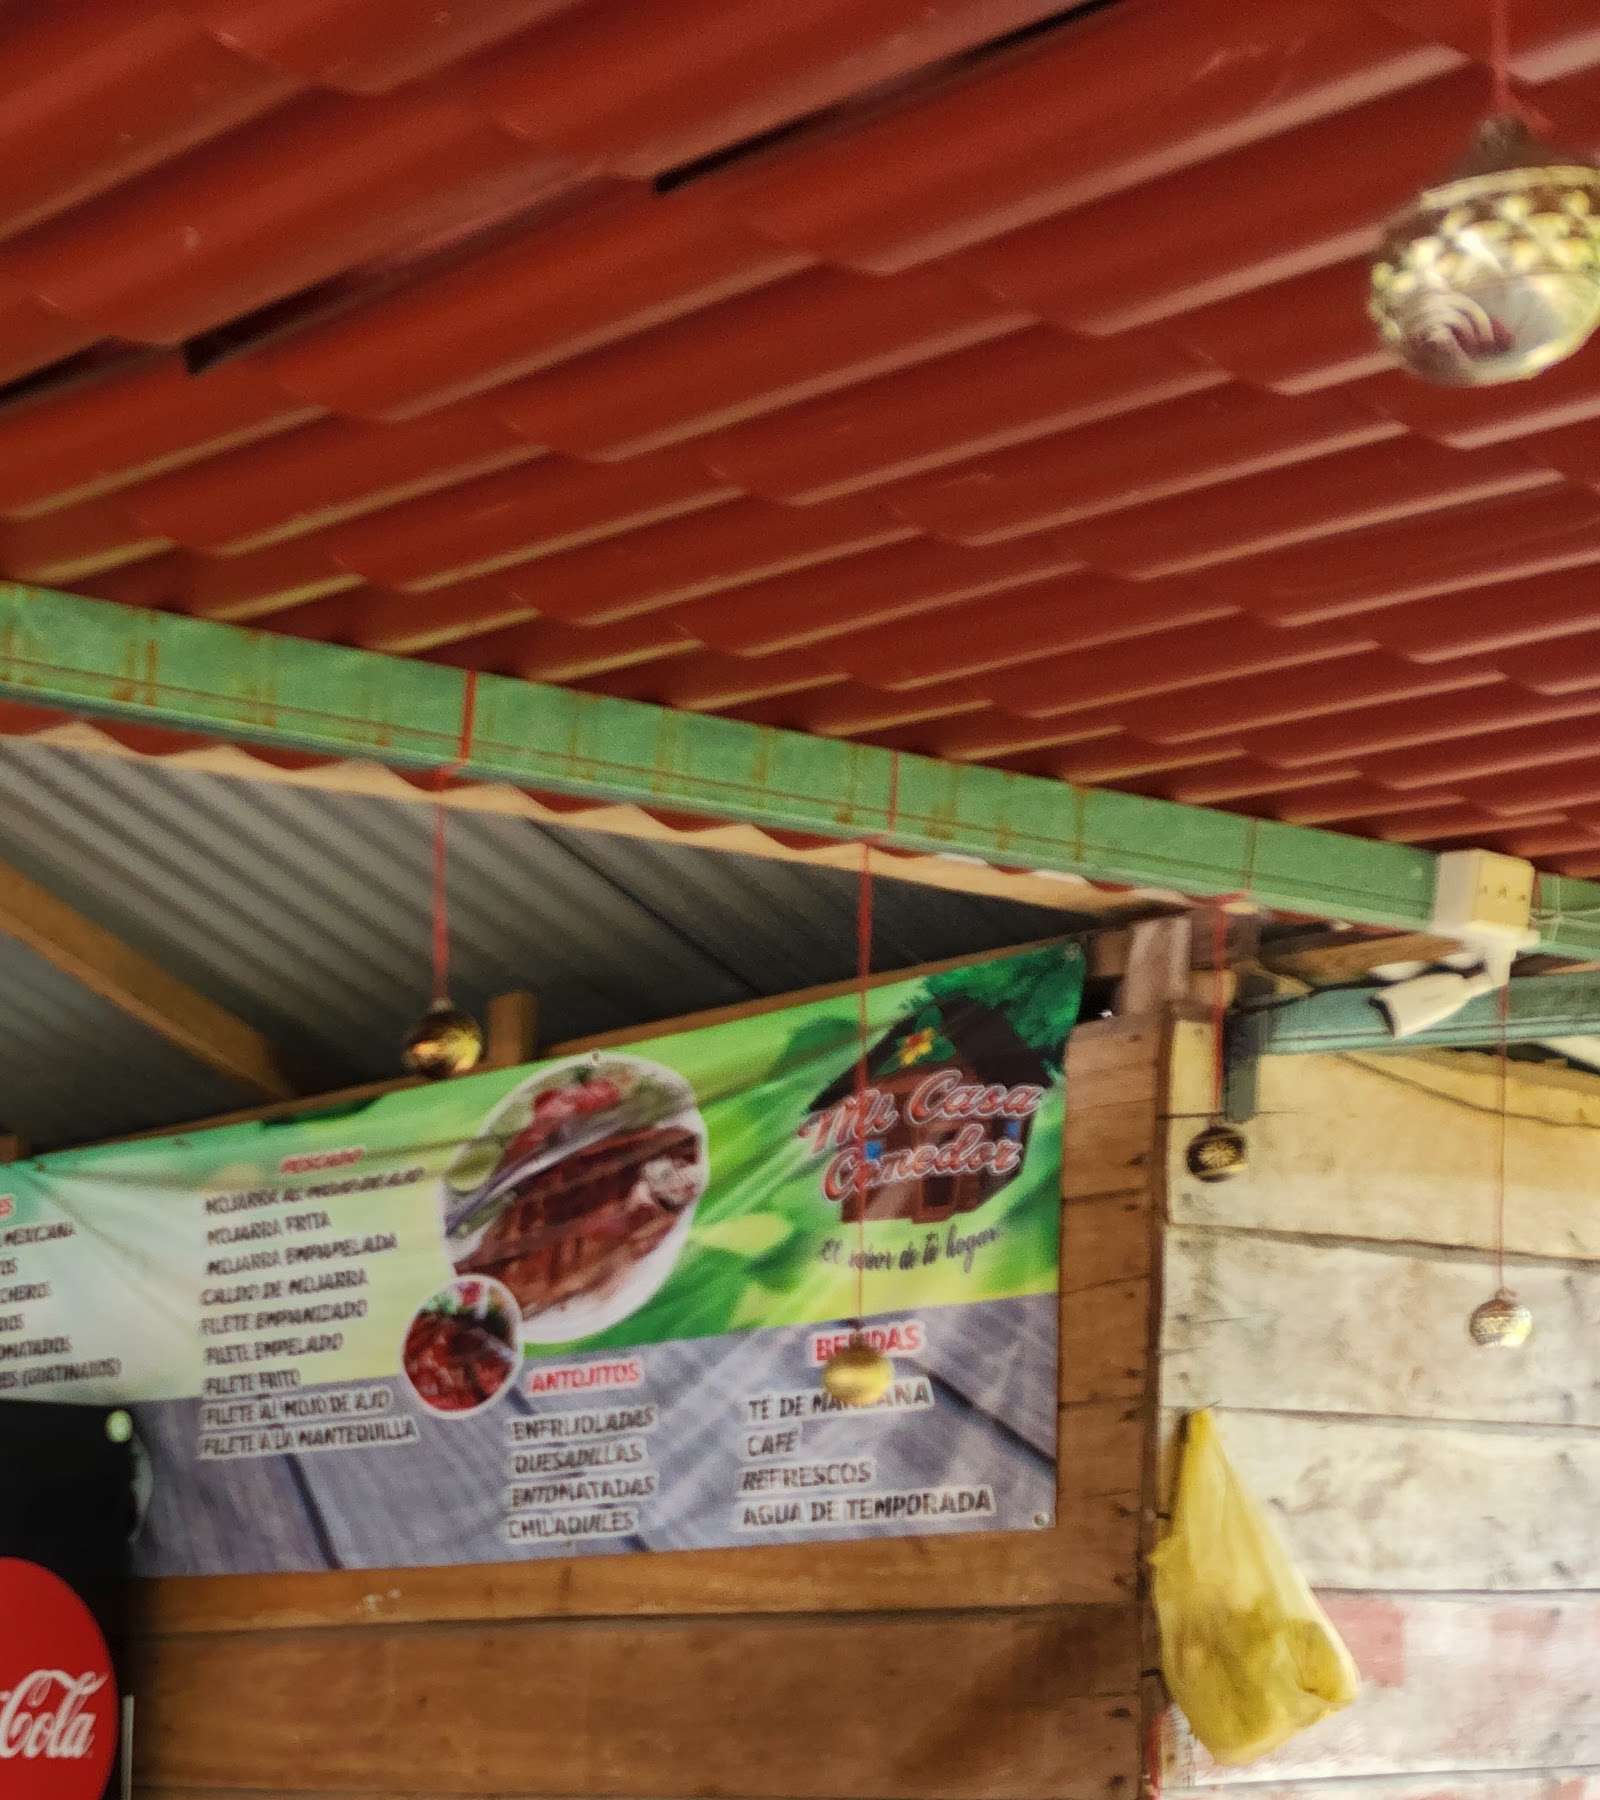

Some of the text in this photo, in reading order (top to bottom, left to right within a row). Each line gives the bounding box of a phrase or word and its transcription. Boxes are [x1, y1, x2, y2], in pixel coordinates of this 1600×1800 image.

[909, 1069, 1045, 1124] Casa
[823, 1124, 1023, 1201] Comedor
[207, 1218, 281, 1245] MOJARRA
[206, 1250, 280, 1276] MOJARRA
[288, 1268, 367, 1295] MOJARRA
[201, 1314, 250, 1336] FILETE
[204, 1344, 249, 1366] FILETE
[816, 1323, 923, 1362] BEIDAS
[205, 1373, 252, 1394] FILETE
[531, 1360, 640, 1393] ANTOJITOS
[205, 1404, 252, 1425] FILETE
[779, 1394, 804, 1417] DE
[203, 1434, 251, 1456] FILETE
[299, 1419, 418, 1447] MANTEQUILLA
[511, 1406, 655, 1442] ENFRIJOLADAS
[514, 1443, 644, 1474] QUESADILLAS
[742, 1461, 873, 1491] REFRESCOS
[511, 1475, 655, 1508] ENTOMATADAS
[742, 1488, 992, 1527] AGUA DE TEMPORADA
[506, 1510, 634, 1540] CHILAQUILES
